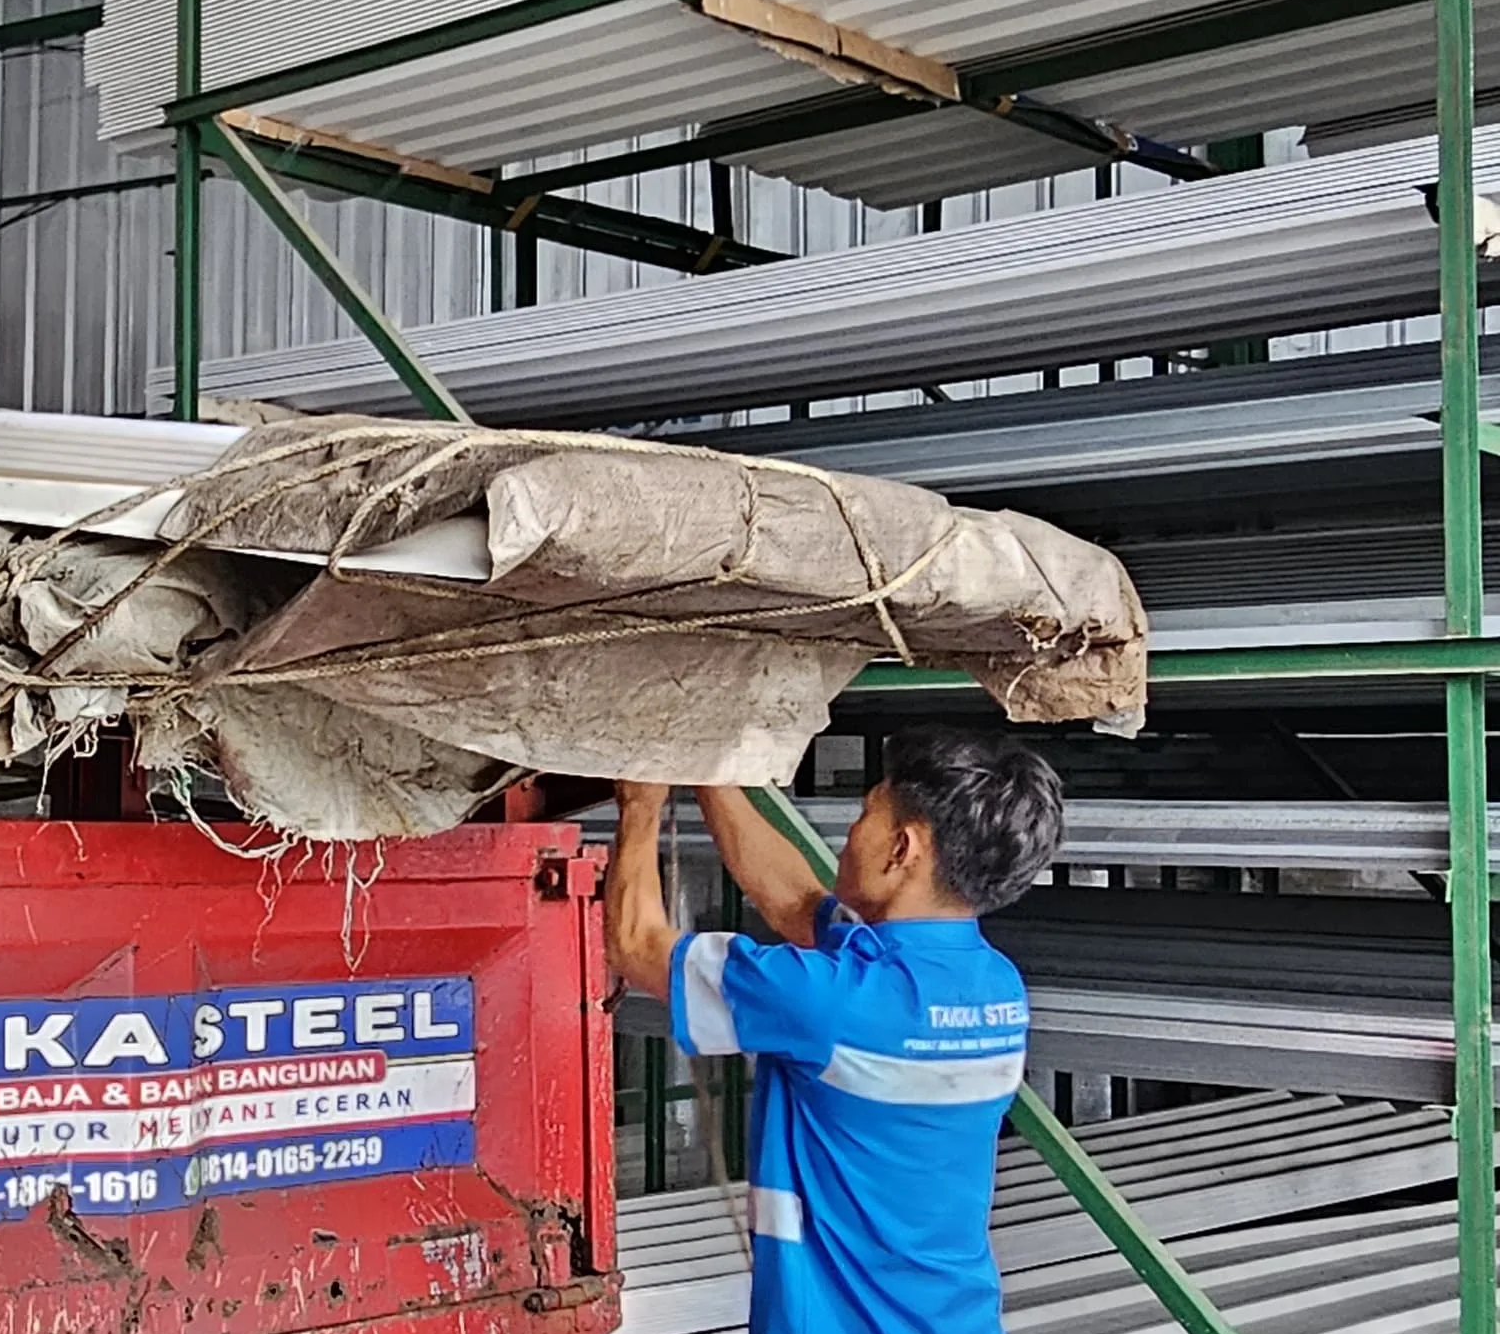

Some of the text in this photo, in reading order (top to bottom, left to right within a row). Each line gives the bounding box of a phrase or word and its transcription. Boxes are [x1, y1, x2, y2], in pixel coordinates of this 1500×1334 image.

[192, 990, 460, 1059] STEEL
[101, 1081, 131, 1106] &
[140, 1071, 214, 1104] BAHN
[217, 1056, 376, 1091] BANGUNAN
[295, 1087, 412, 1117] ECERAN
